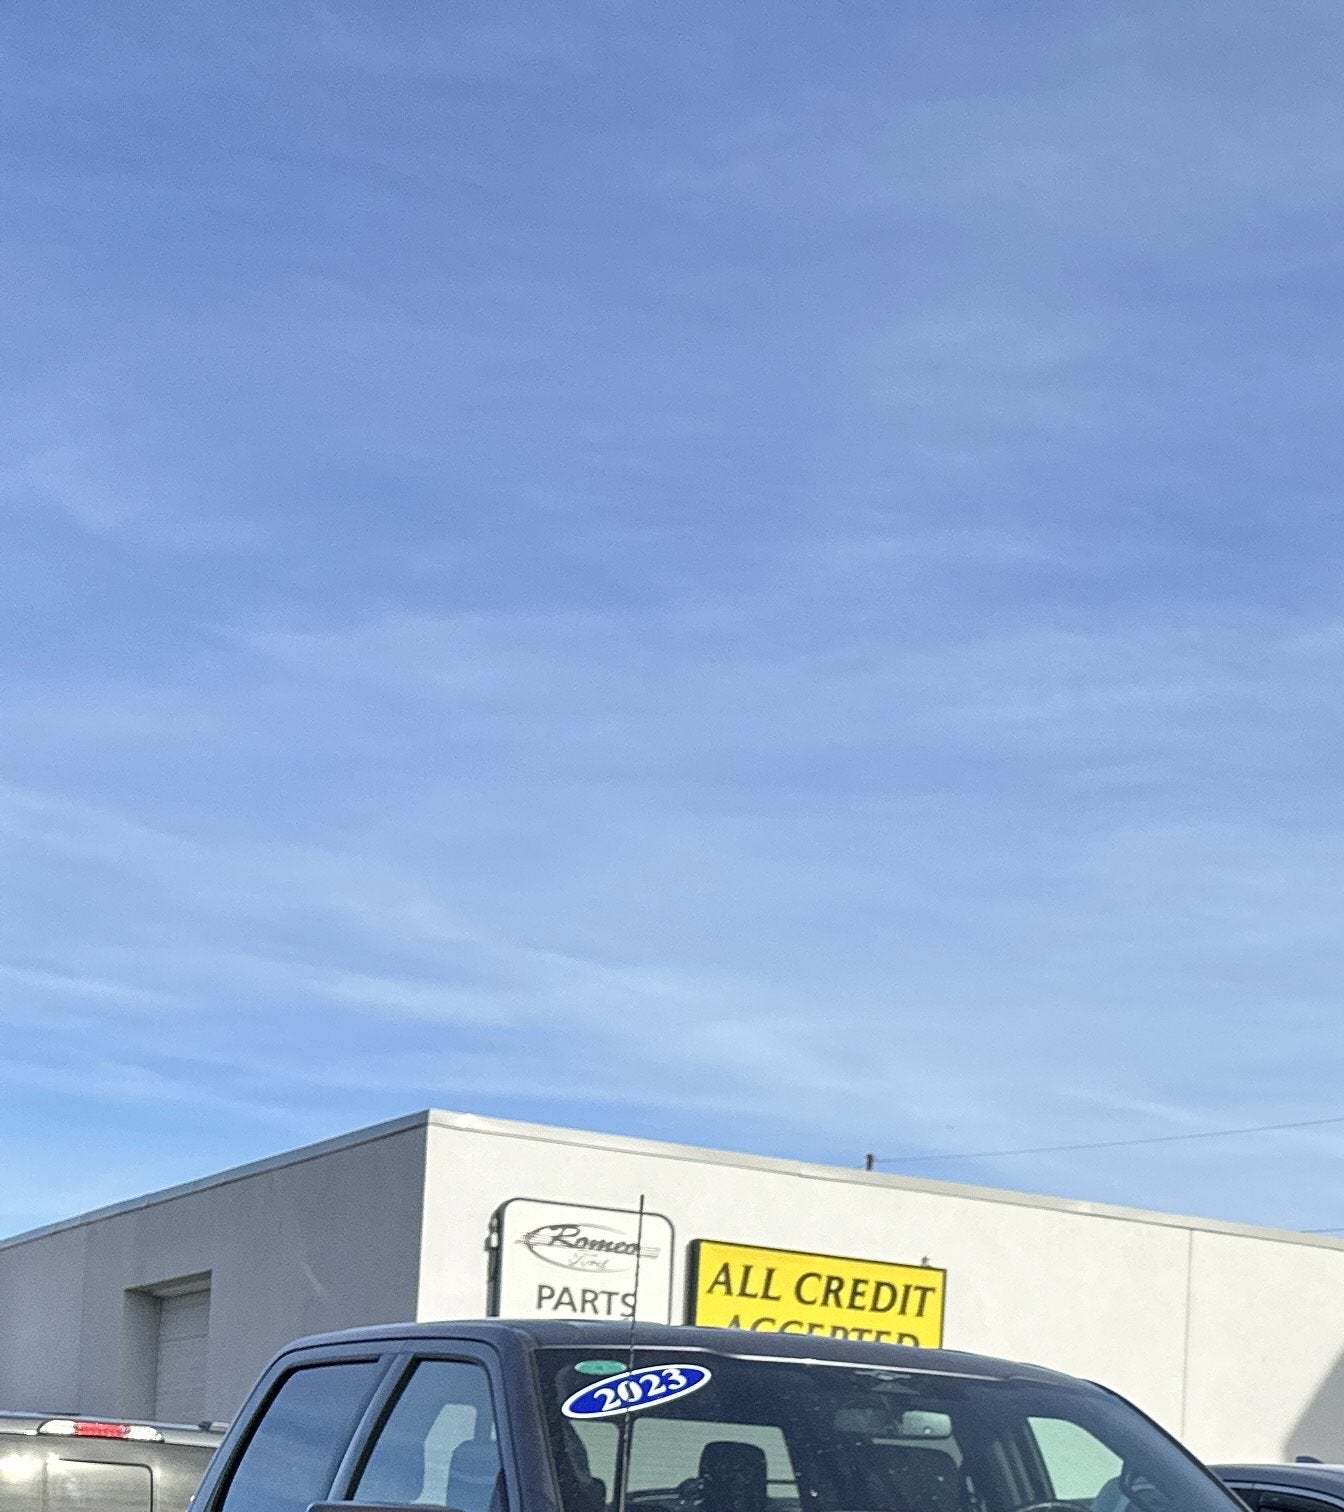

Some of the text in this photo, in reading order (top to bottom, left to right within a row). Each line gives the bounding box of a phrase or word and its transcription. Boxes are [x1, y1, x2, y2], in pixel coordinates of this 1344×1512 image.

[549, 1224, 640, 1255] Romeo
[536, 1284, 637, 1317] PARTS
[706, 1262, 936, 1317] ALL CREDIT
[594, 1368, 687, 1411] 2023
